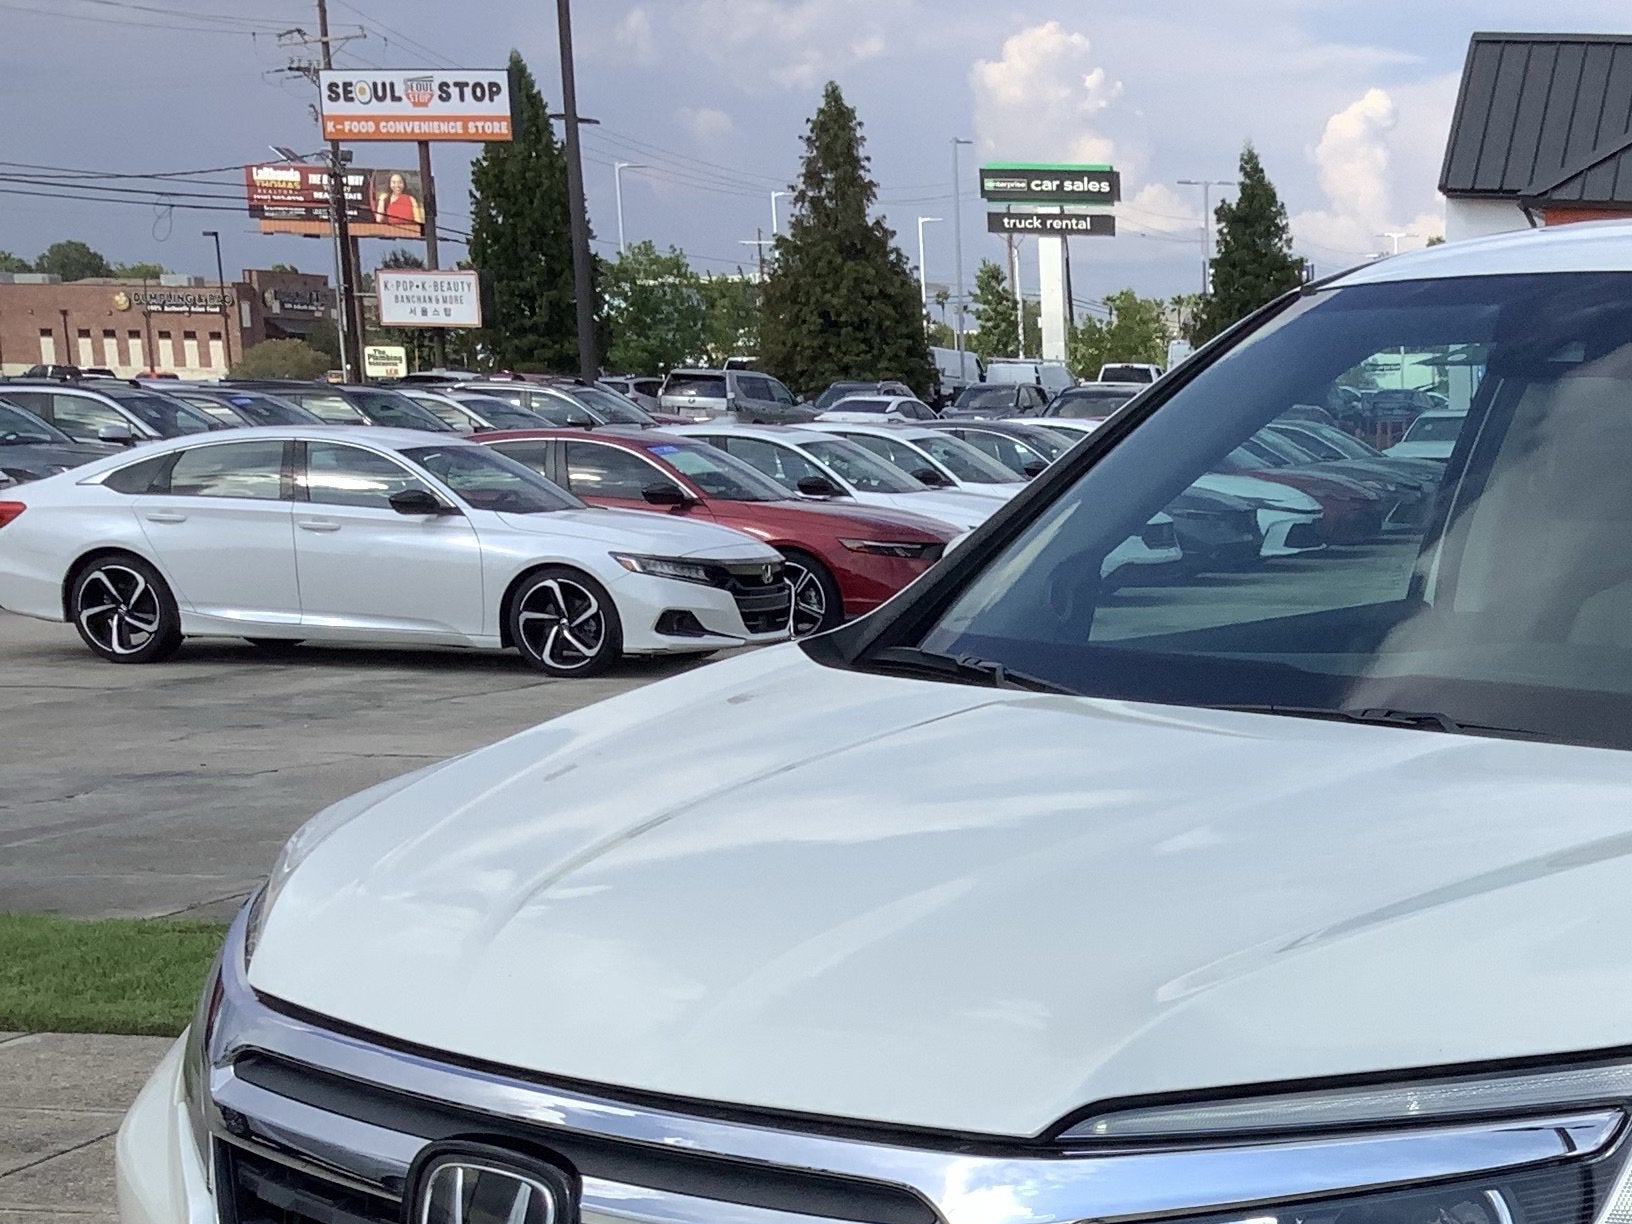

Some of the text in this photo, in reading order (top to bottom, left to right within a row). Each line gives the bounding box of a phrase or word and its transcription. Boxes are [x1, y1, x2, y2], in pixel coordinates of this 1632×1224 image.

[327, 80, 502, 104] SEOUL STOP
[326, 121, 509, 134] K-FOOD CONVENIENCE STORE
[1030, 179, 1059, 192] car
[1063, 176, 1110, 193] sales
[1003, 216, 1091, 230] truck rental
[394, 294, 433, 305] BANCHAN
[441, 296, 464, 305] MORE
